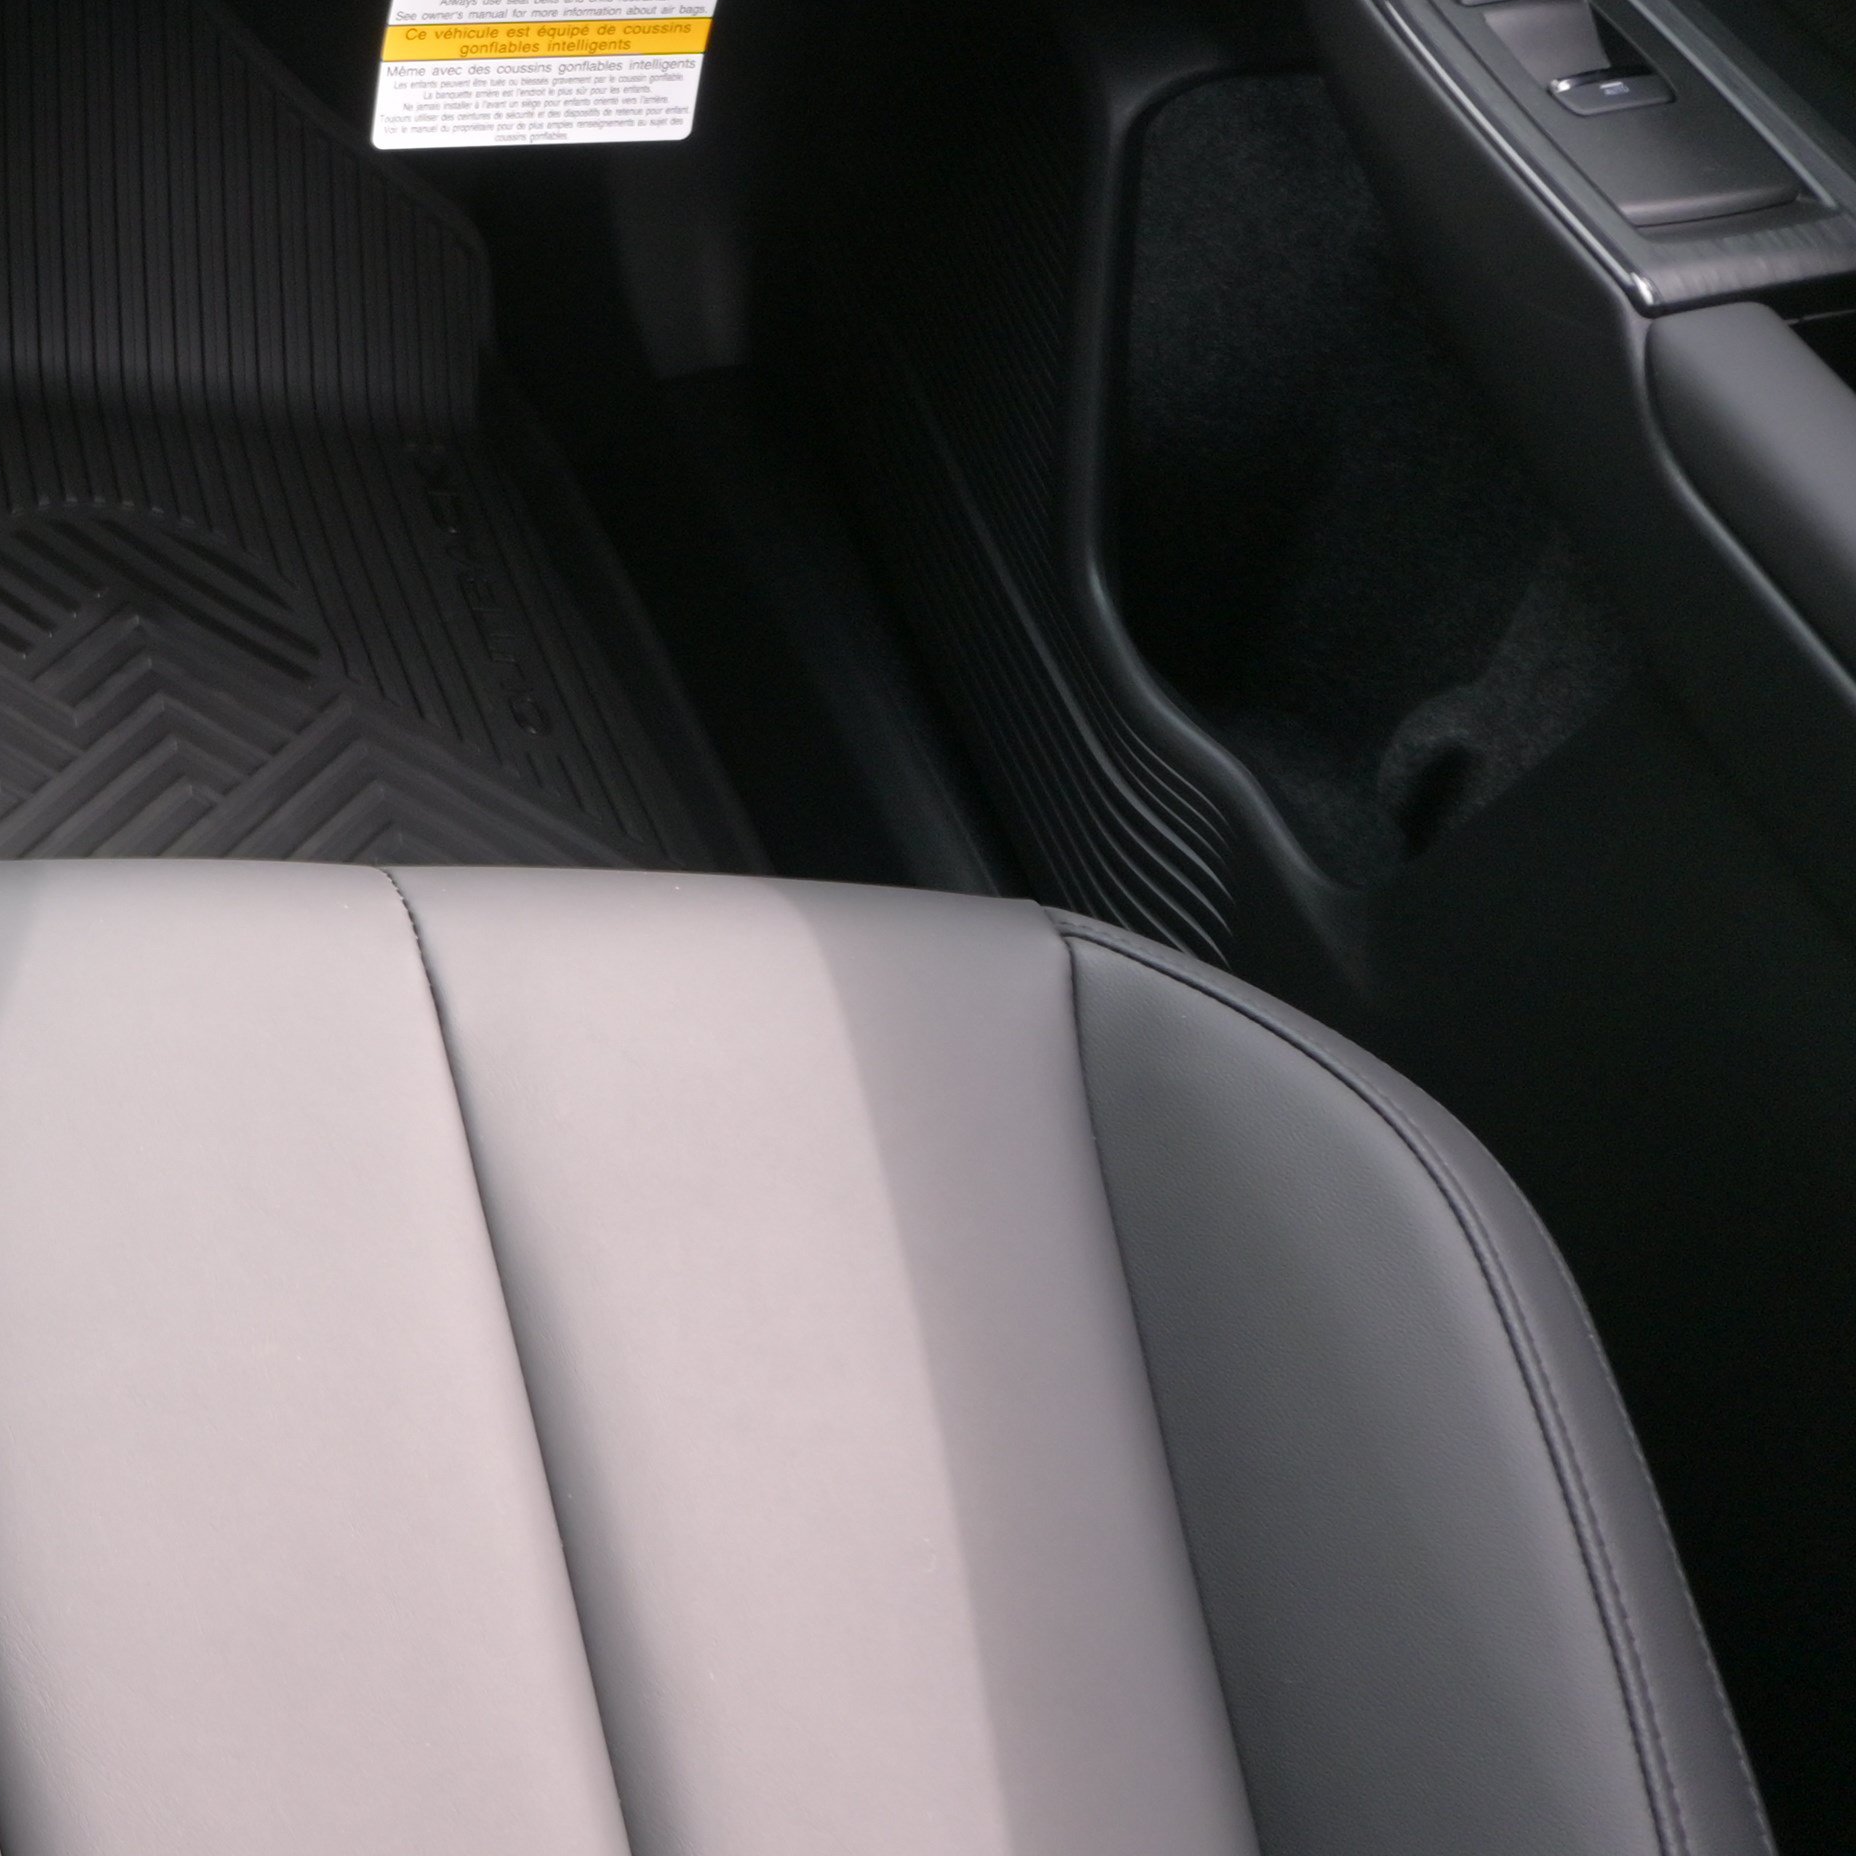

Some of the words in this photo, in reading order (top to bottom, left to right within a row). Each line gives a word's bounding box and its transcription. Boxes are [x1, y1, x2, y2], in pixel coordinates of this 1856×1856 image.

[396, 11, 417, 22] See
[422, 10, 464, 21] owner's
[468, 10, 509, 19] manual
[513, 9, 527, 18] for
[531, 10, 559, 18] more
[563, 6, 623, 17] information
[626, 6, 657, 16] about
[661, 6, 676, 15] air
[679, 5, 708, 16] bags.
[405, 28, 427, 41] Ce
[435, 27, 499, 40] véhicule
[506, 27, 531, 38] est
[537, 25, 590, 39] équipé
[596, 24, 616, 36] de
[623, 22, 692, 35] coussins
[547, 39, 632, 54] intelligents
[387, 66, 426, 77] Même
[432, 67, 463, 76] avec
[468, 65, 491, 76] des
[496, 63, 553, 75] coussins
[629, 59, 697, 72] intelligents
